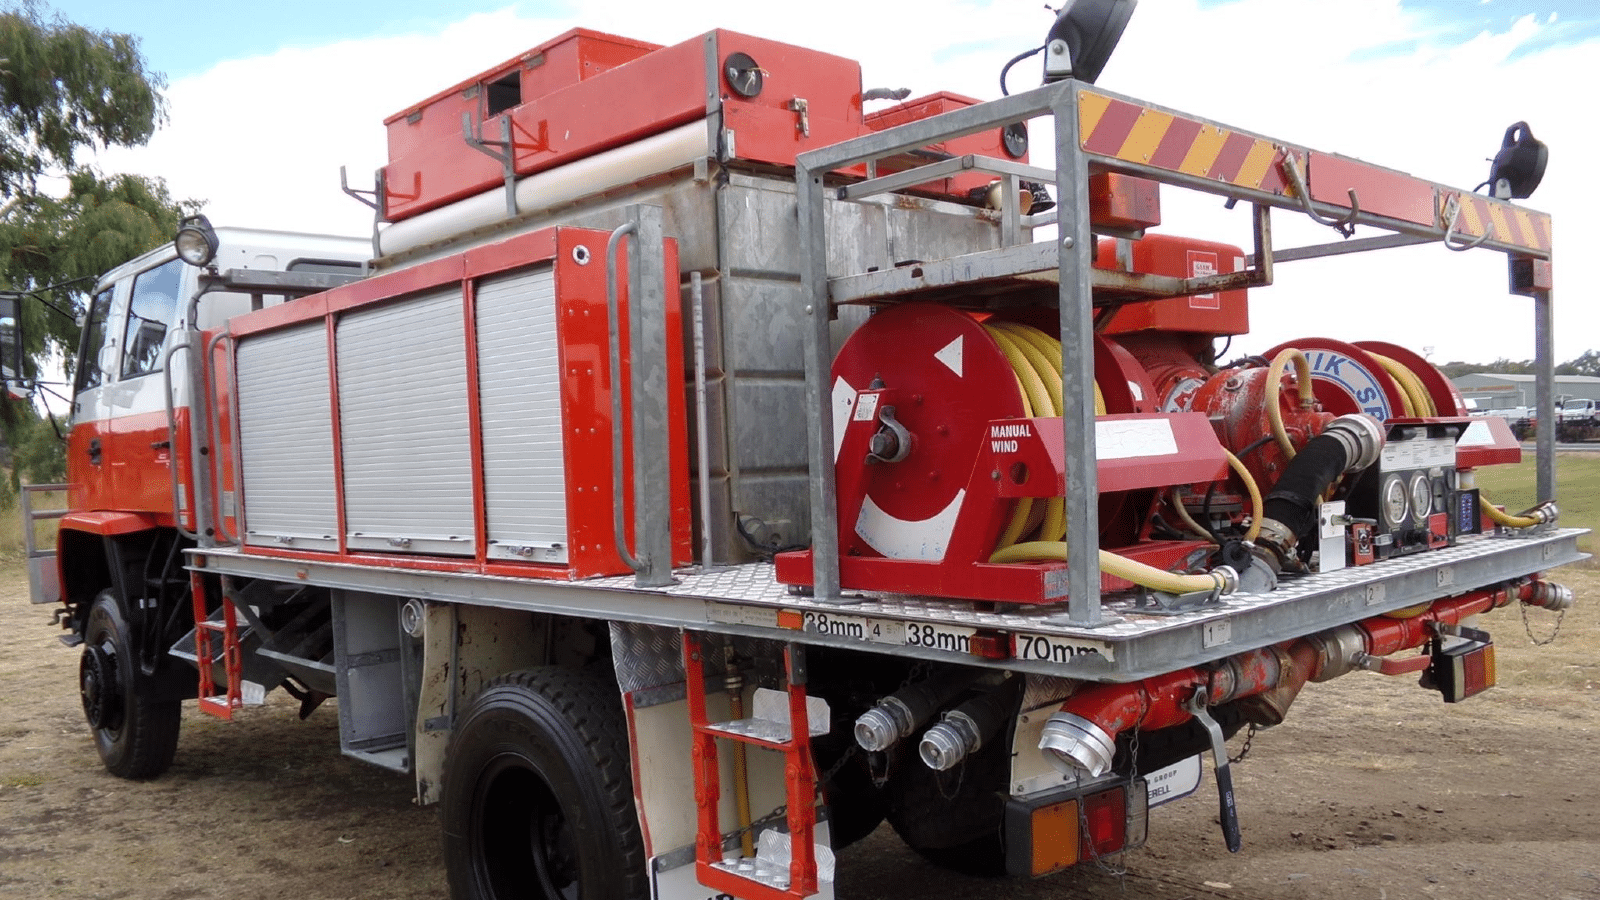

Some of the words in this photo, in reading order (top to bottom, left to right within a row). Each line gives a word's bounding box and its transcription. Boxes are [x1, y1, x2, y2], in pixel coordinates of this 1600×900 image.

[991, 424, 1032, 438] MANUAL
[991, 440, 1018, 453] WIND
[1438, 570, 1444, 583] 3
[1368, 587, 1374, 600] 2
[873, 623, 881, 637] 4
[1208, 626, 1213, 642] 1
[1154, 769, 1178, 783] GROUP
